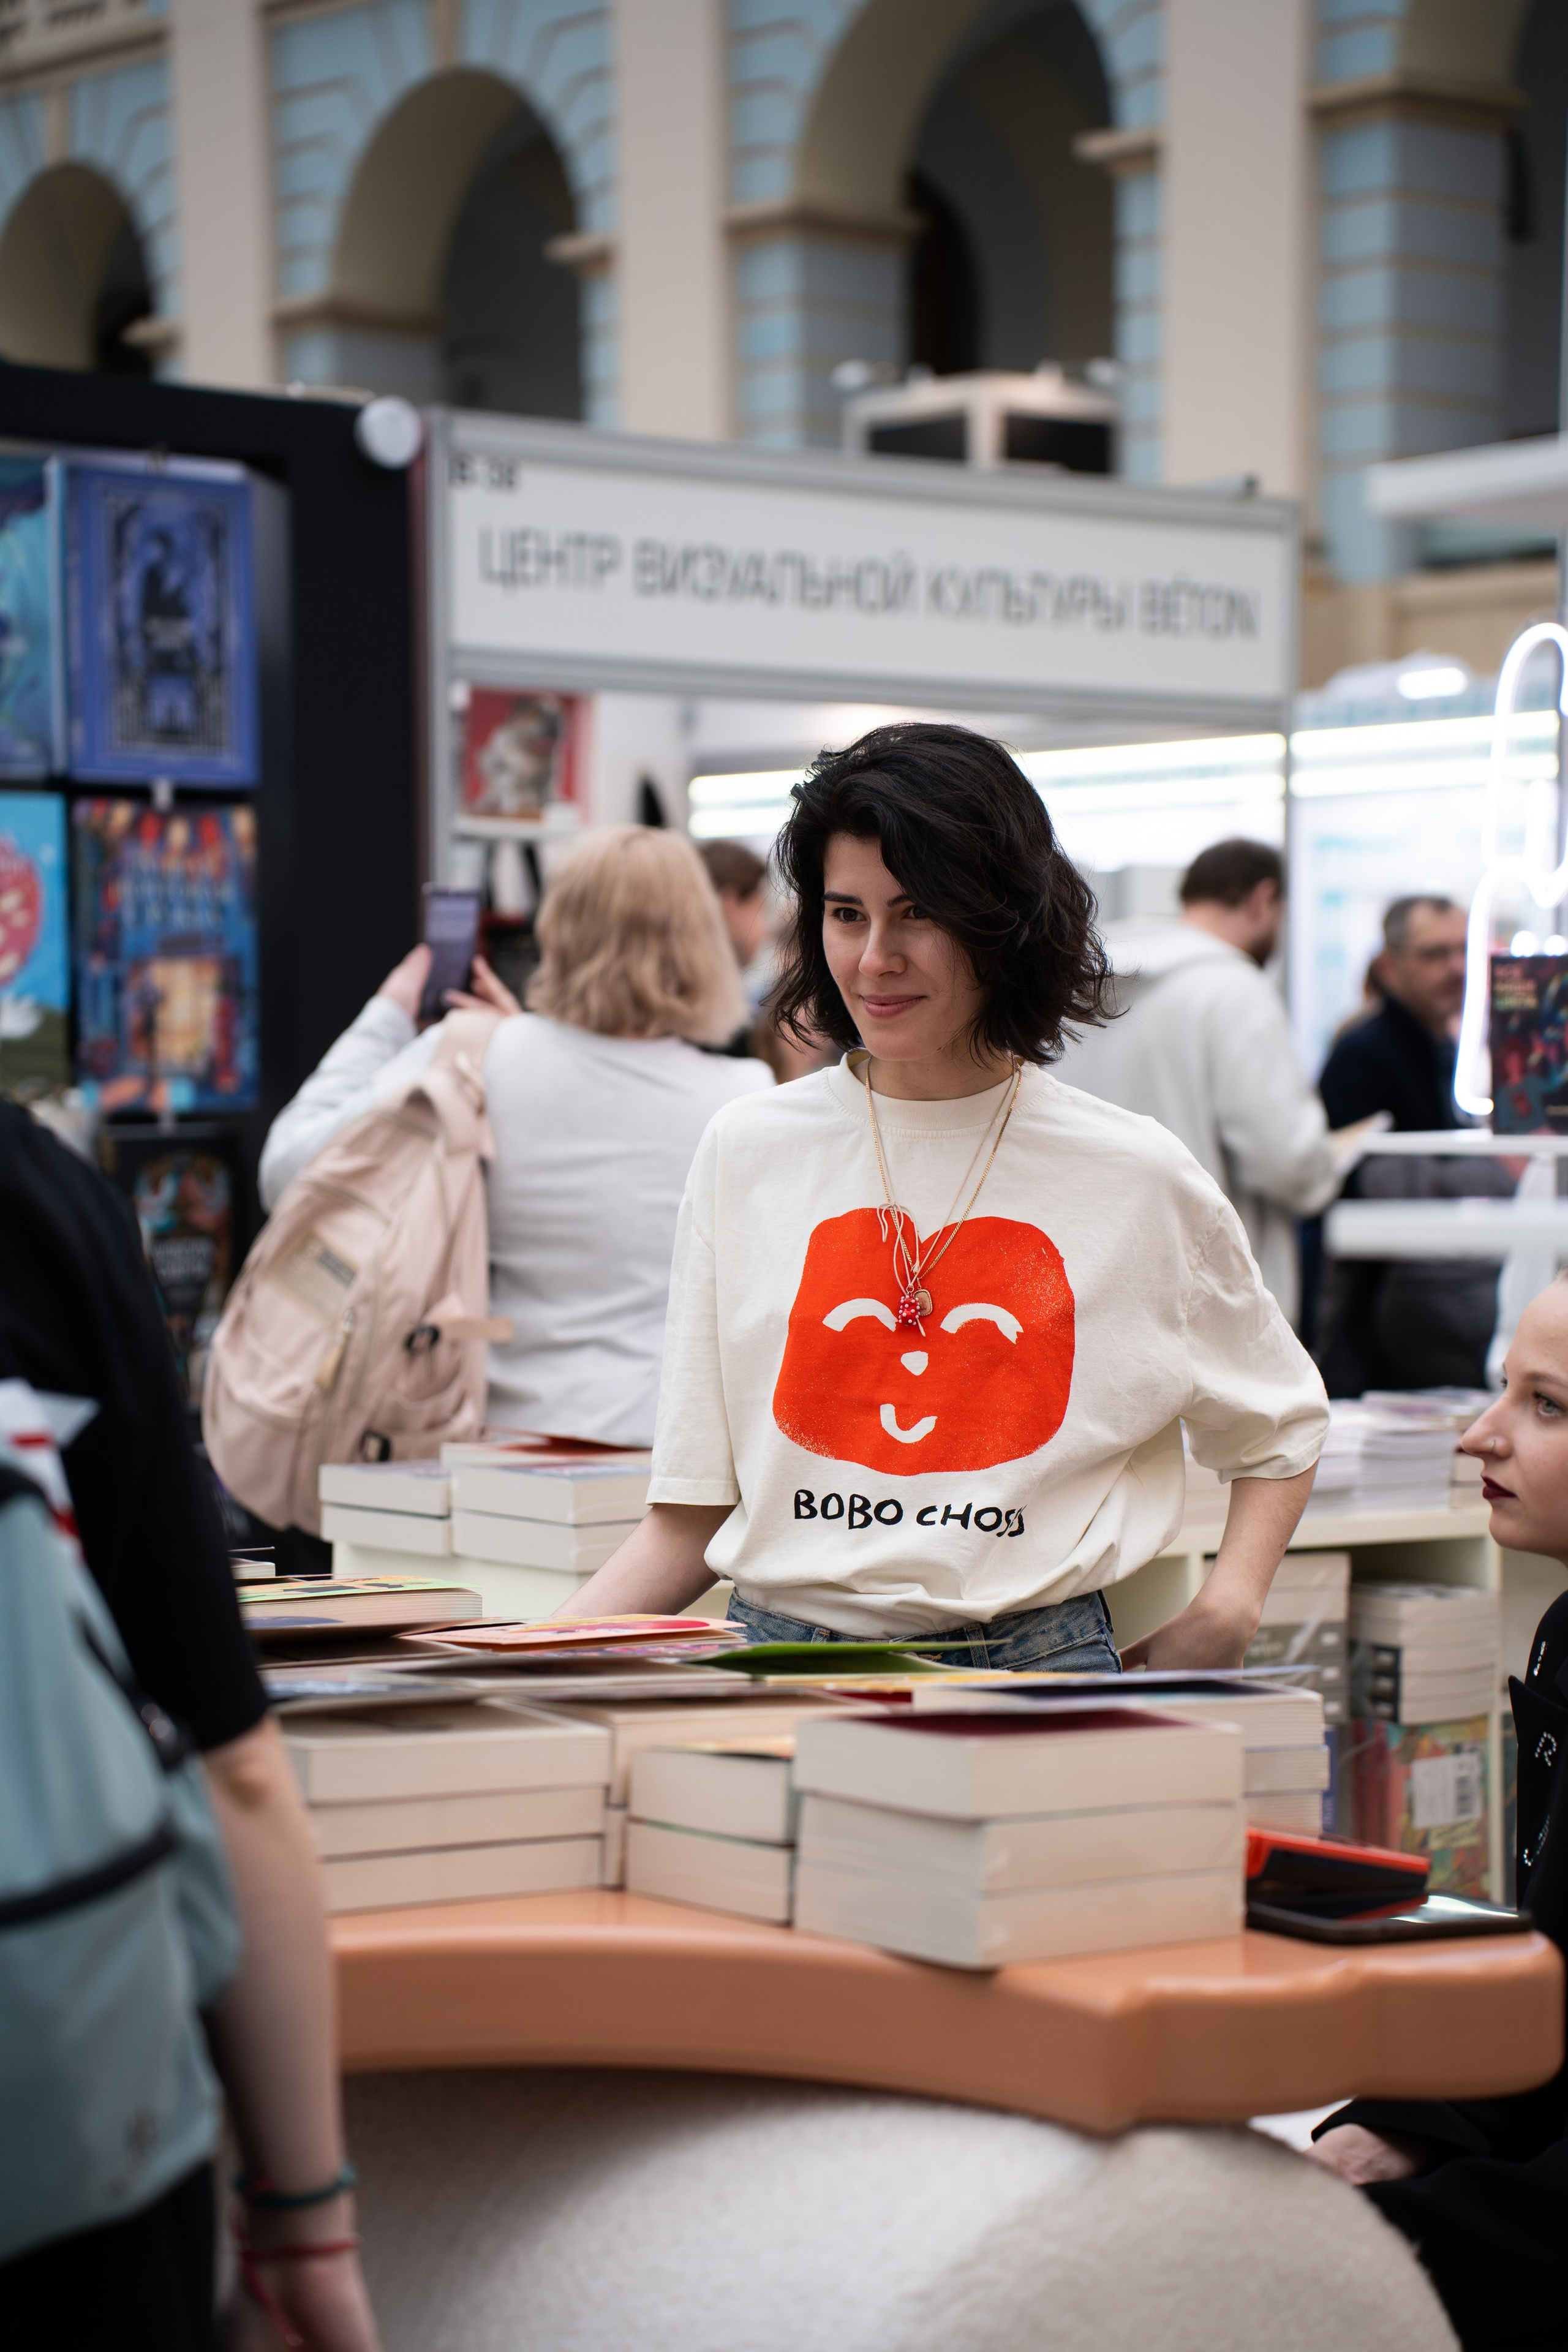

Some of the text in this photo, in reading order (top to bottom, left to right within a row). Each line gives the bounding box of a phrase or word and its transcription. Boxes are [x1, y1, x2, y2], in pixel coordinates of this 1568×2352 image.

[480, 527, 620, 594] ЦЕНТР
[634, 541, 916, 613] ВИЗУАЛЬНОЙ
[925, 565, 1127, 633] КУЛЬТУРЫ
[794, 1489, 903, 1529] BOBO
